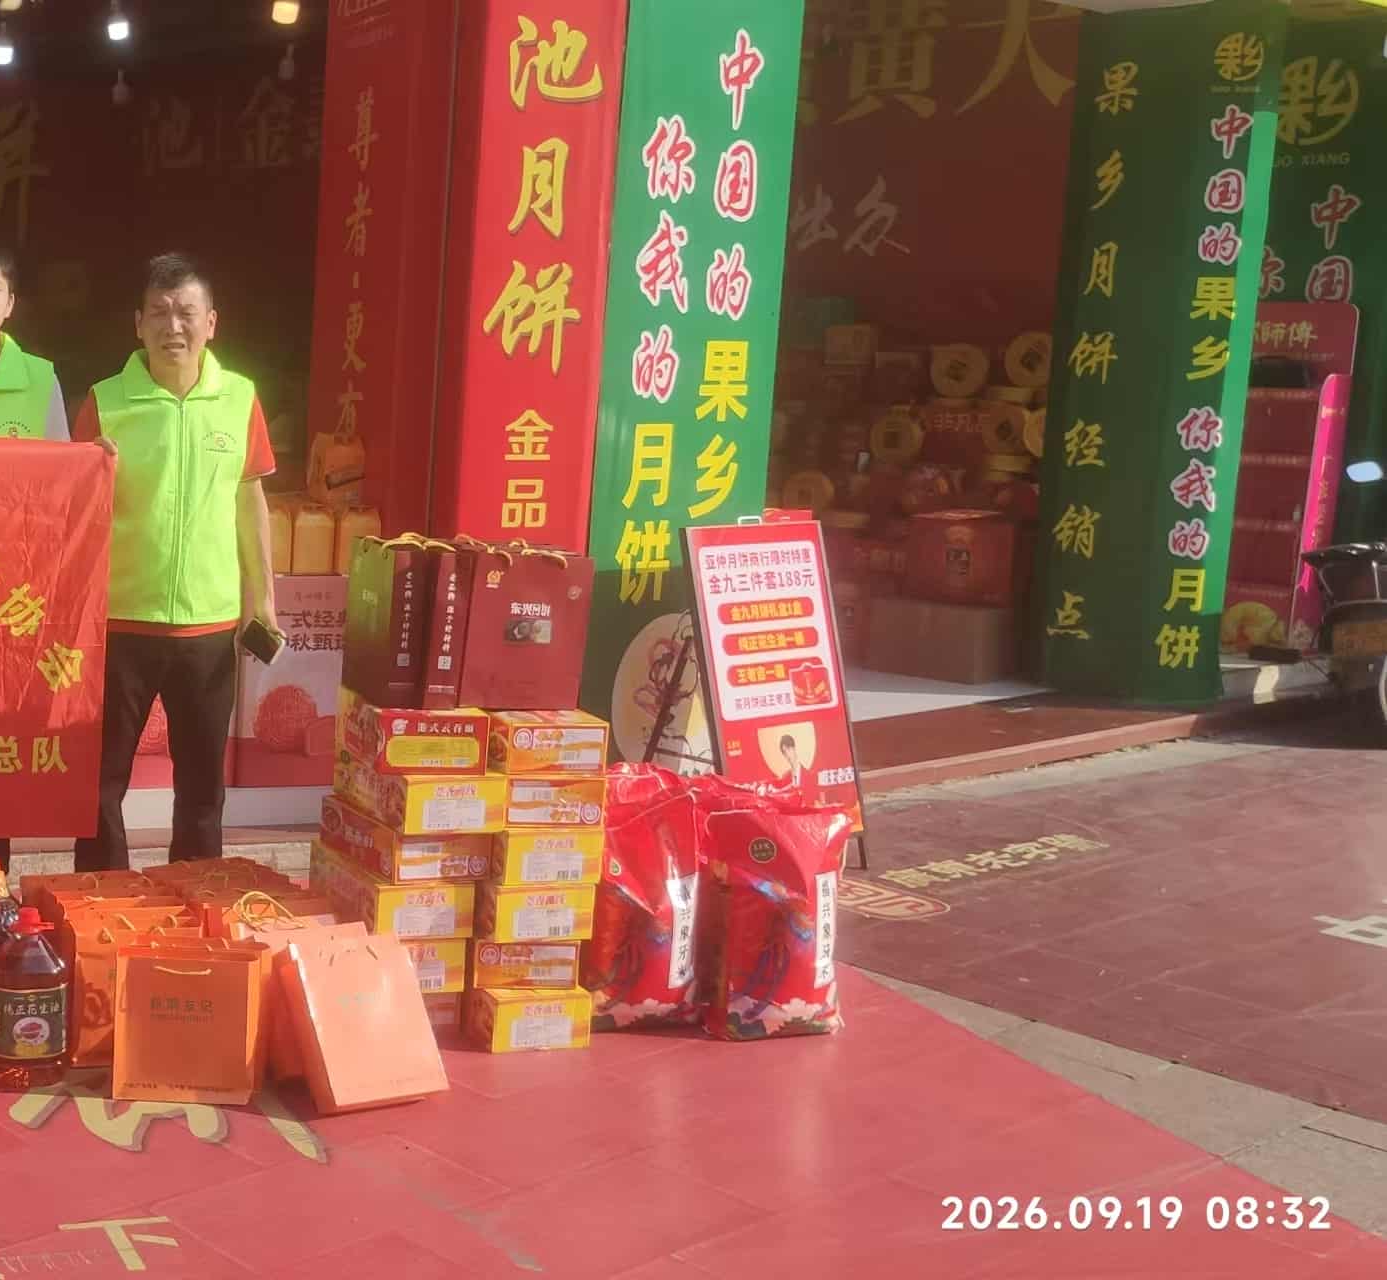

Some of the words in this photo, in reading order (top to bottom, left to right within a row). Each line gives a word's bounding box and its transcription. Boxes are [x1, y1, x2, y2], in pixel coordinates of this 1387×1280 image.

[500, 408, 555, 529] 金品
[612, 114, 697, 606] 你我的月饼
[687, 28, 764, 520] 中国的果乡
[1046, 60, 1140, 641] 果乡月饼经销点
[708, 569, 816, 594] 金九三件套188元
